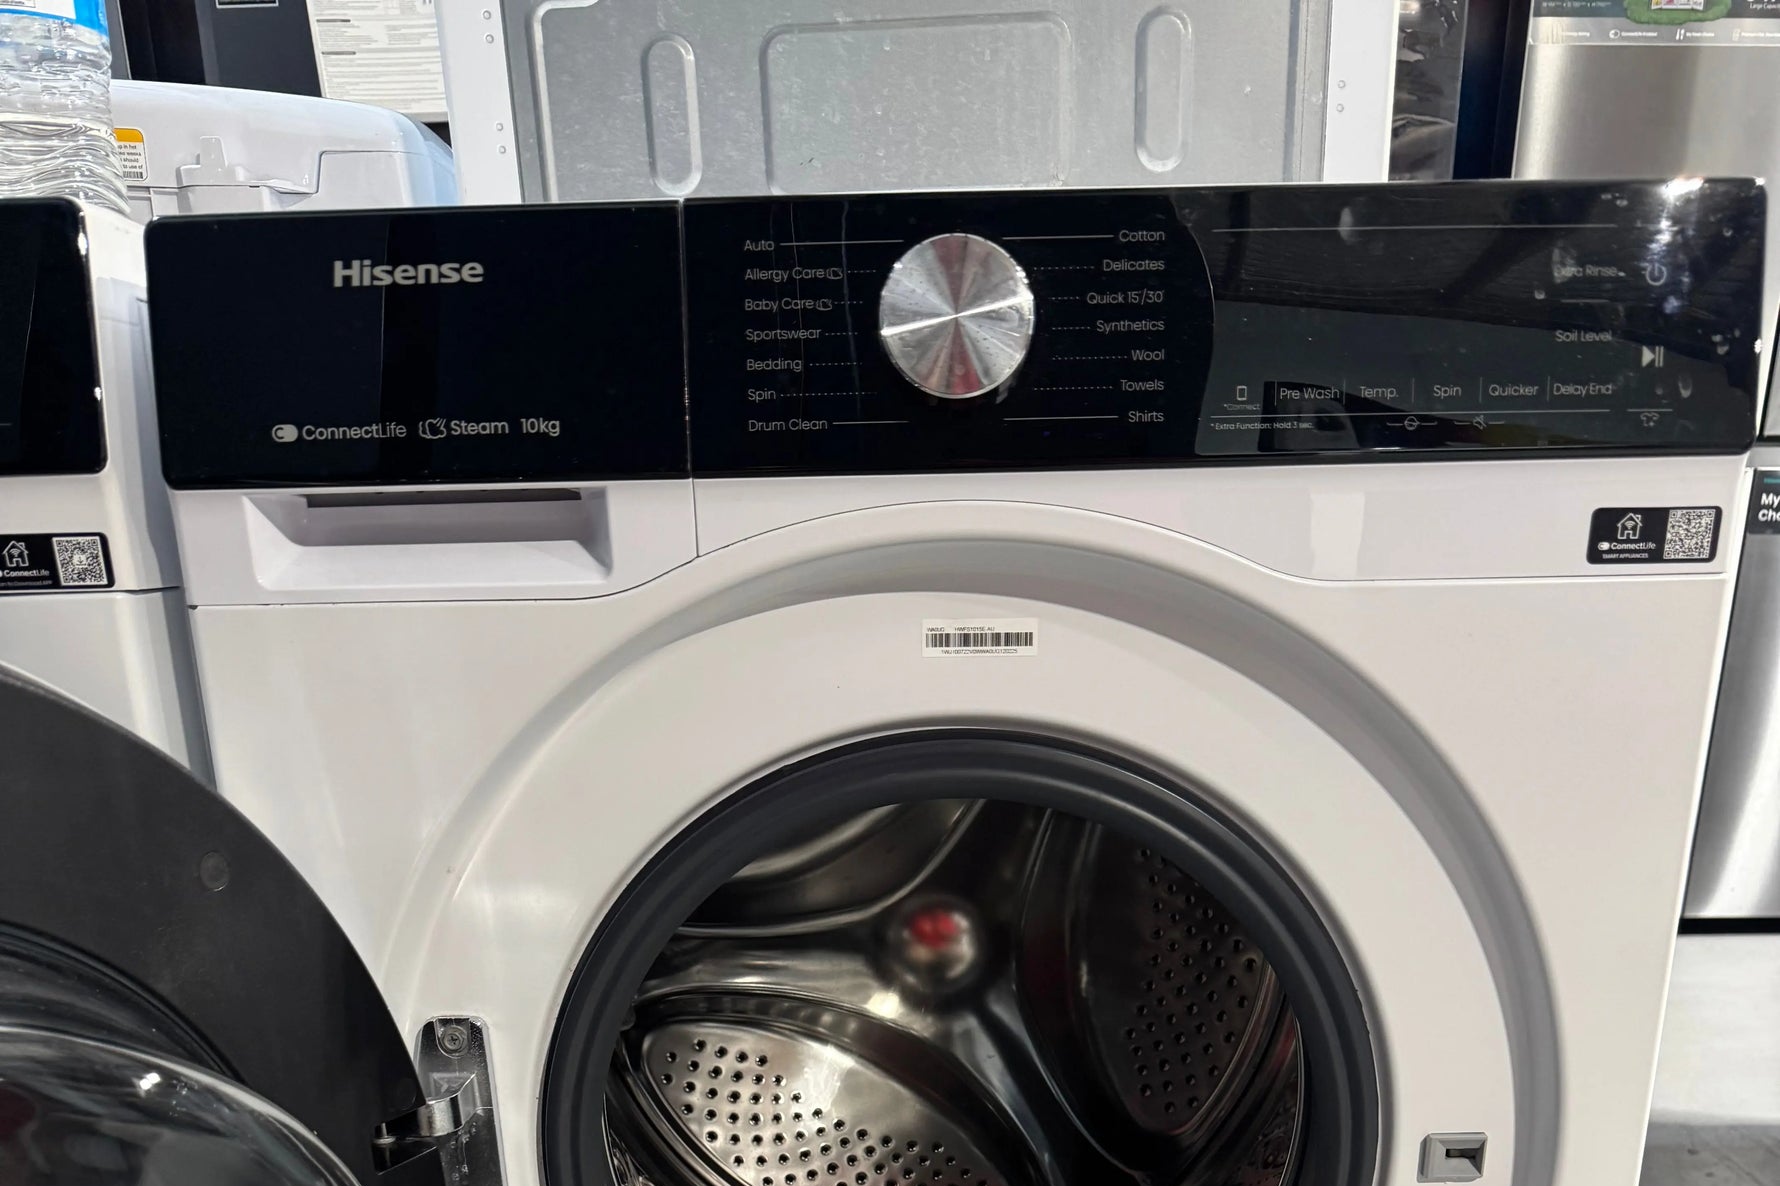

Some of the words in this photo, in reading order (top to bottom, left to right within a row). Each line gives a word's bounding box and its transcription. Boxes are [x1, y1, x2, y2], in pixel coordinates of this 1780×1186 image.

[1119, 229, 1165, 242] Cotton
[744, 239, 775, 251] Auto
[1103, 259, 1165, 271] Delicates
[1585, 264, 1617, 277] Rinse
[333, 259, 484, 287] Hisense
[745, 268, 789, 282] Allergy
[792, 267, 825, 279] Care
[745, 298, 779, 312] Baby
[781, 297, 814, 309] Care
[1087, 291, 1125, 304] Quick
[1096, 319, 1165, 334] Synthetics
[745, 328, 822, 343] Sportswear
[1555, 329, 1578, 342] Soil
[1581, 329, 1612, 342] Level
[1131, 349, 1165, 361] Wool
[747, 358, 802, 372] Bedding
[1120, 379, 1164, 391] Towels
[1433, 384, 1462, 399] Spin
[1488, 383, 1539, 397] Quicker
[1553, 383, 1588, 397] Delay
[1589, 383, 1613, 394] End
[748, 388, 776, 403] Spin
[1280, 388, 1300, 399] Pre
[1303, 387, 1339, 399] Wash
[1360, 386, 1399, 400] Temp.
[1128, 410, 1164, 422] Shirts
[302, 422, 407, 441] ConnectLife
[450, 418, 509, 435] Steam
[520, 417, 560, 437] 10kg
[748, 420, 786, 432] Drum
[788, 418, 828, 430] Clean
[1761, 492, 1780, 509] My
[1611, 542, 1656, 550] ConnectLife
[4, 569, 50, 577] ConnectLife
